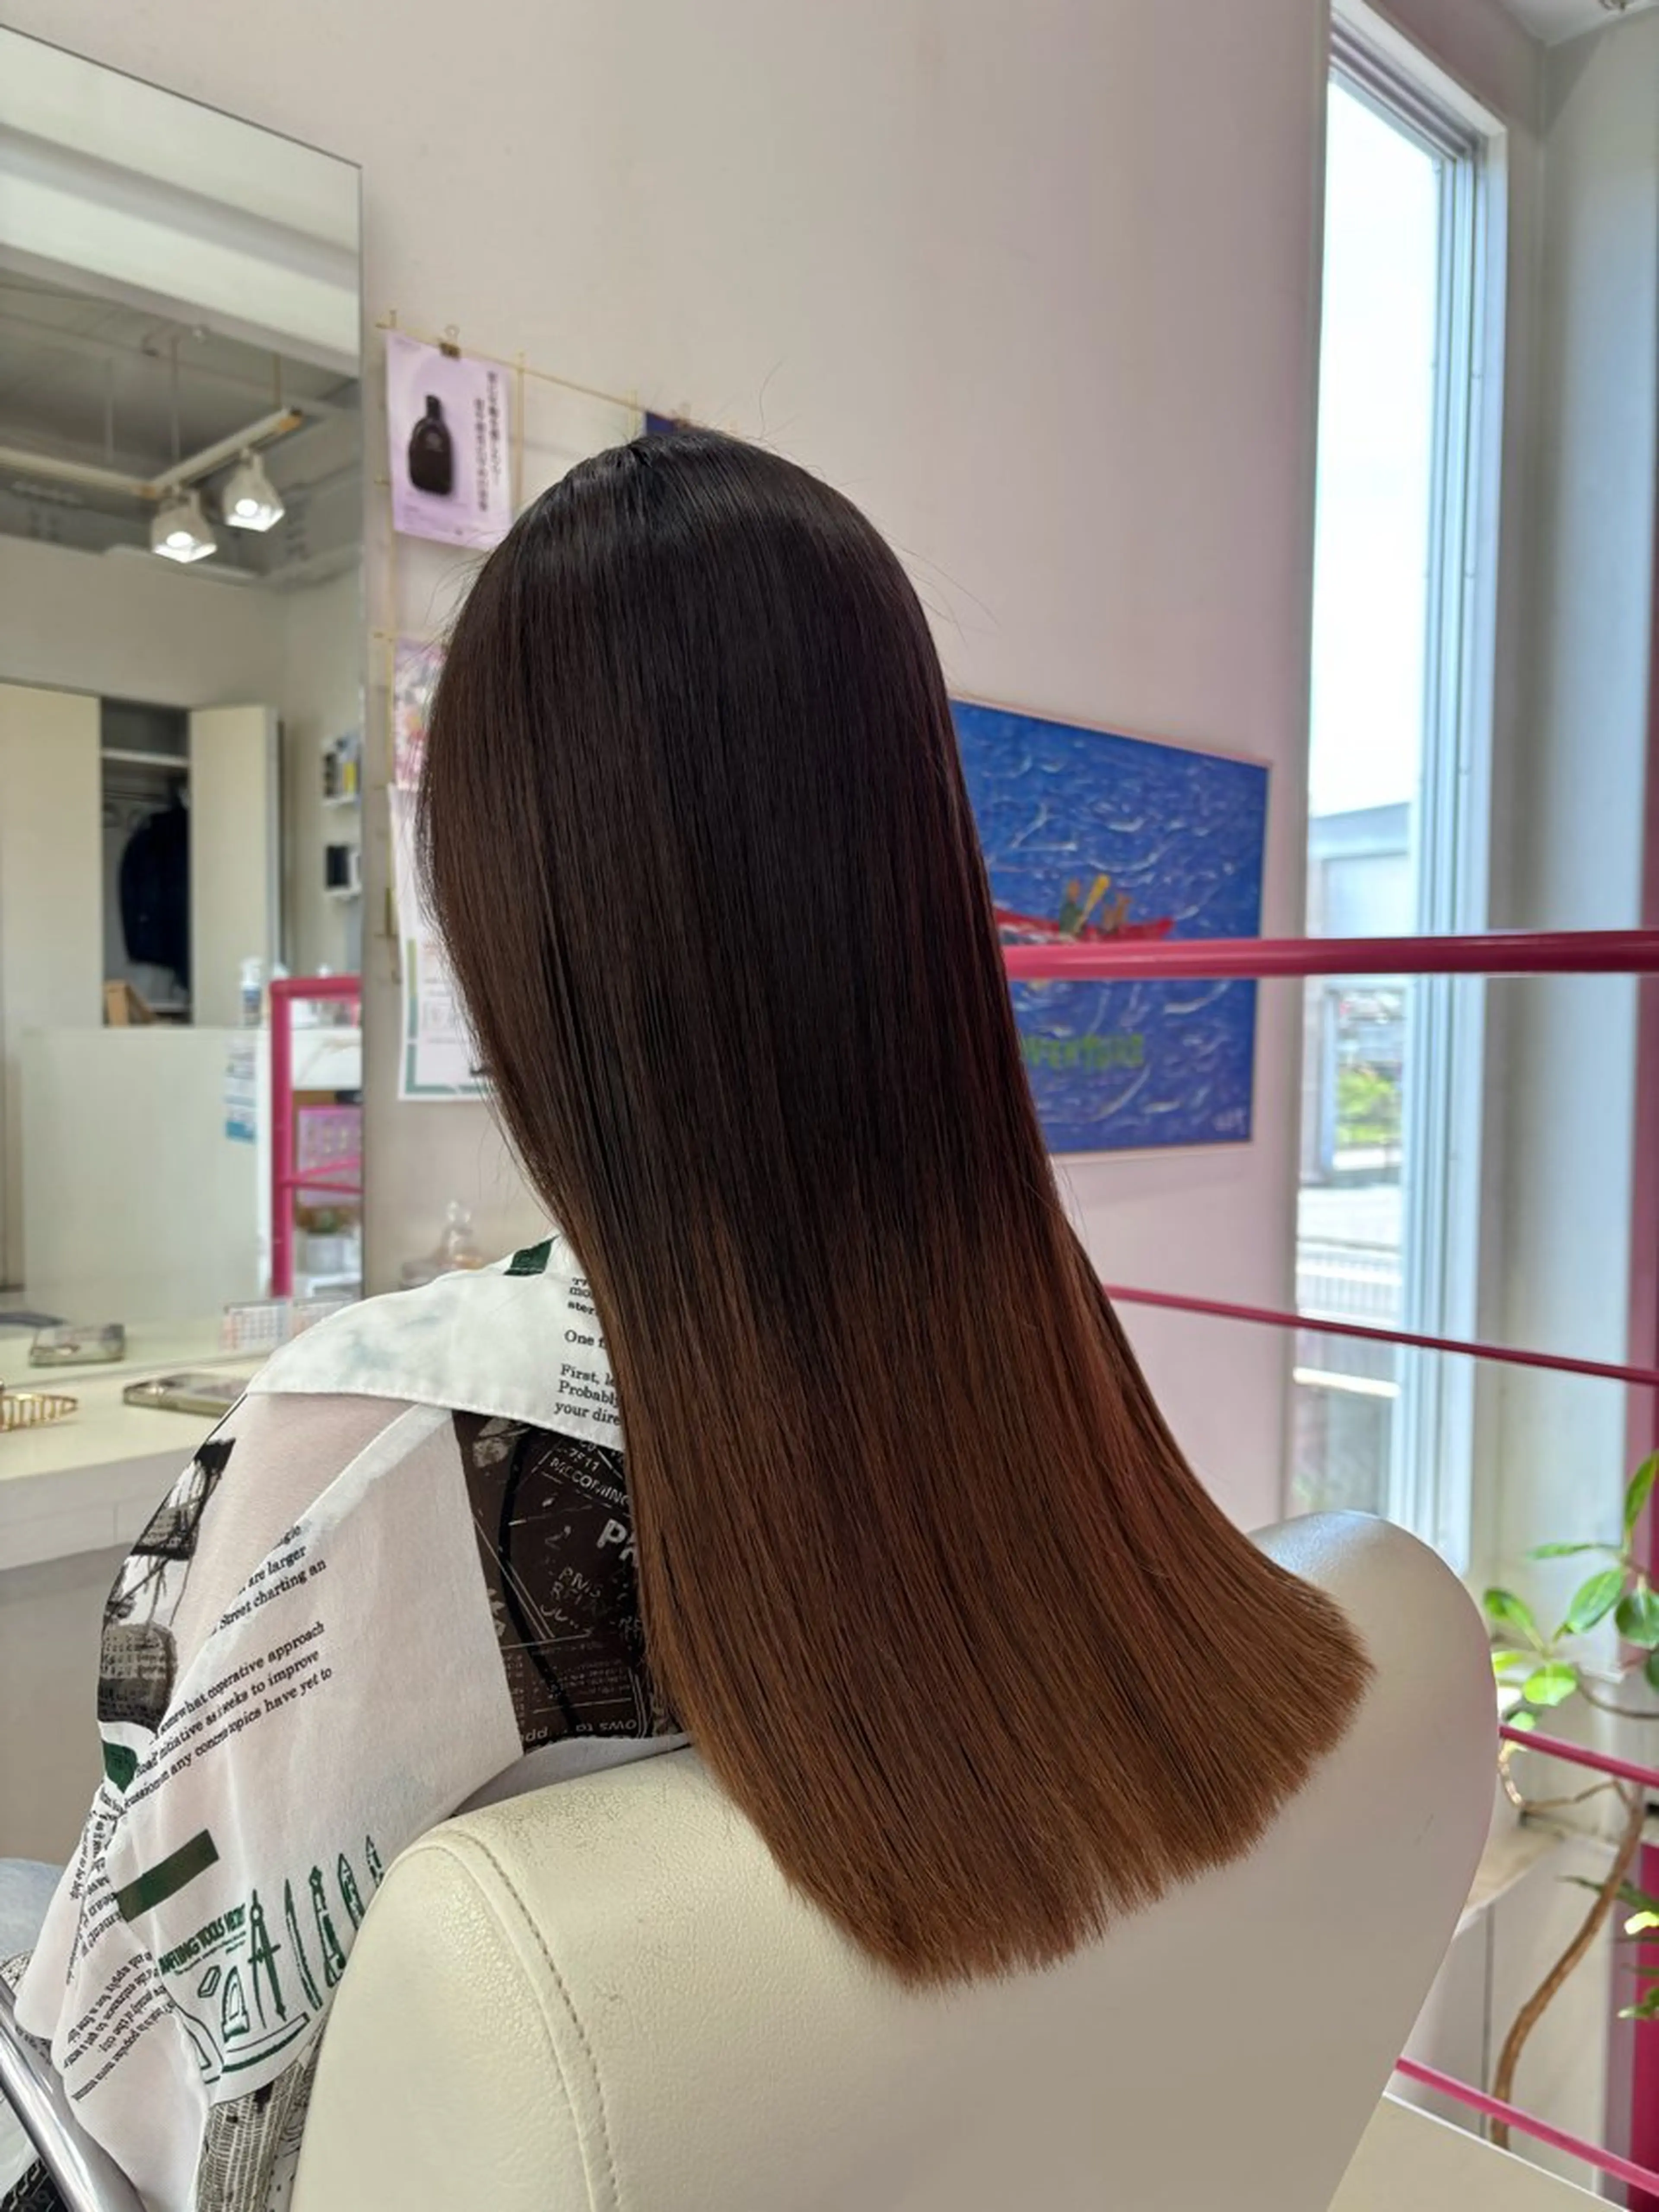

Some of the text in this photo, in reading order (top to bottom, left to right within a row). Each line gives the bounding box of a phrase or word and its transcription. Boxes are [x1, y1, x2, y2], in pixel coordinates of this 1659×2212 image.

[569, 1287, 591, 1298] mo
[567, 1300, 595, 1315] ster
[564, 1329, 595, 1346] One
[560, 1362, 601, 1385] First,
[553, 1401, 623, 1426] your dire
[267, 1545, 307, 1575] larger
[253, 1570, 308, 1608] charting
[308, 1559, 327, 1576] an
[267, 1621, 325, 1663] approach
[250, 1681, 266, 1697] to
[267, 1649, 320, 1687] improve
[170, 1753, 192, 1776] any
[263, 1686, 298, 1714] have
[300, 1673, 320, 1697] yet
[320, 1667, 333, 1682] to
